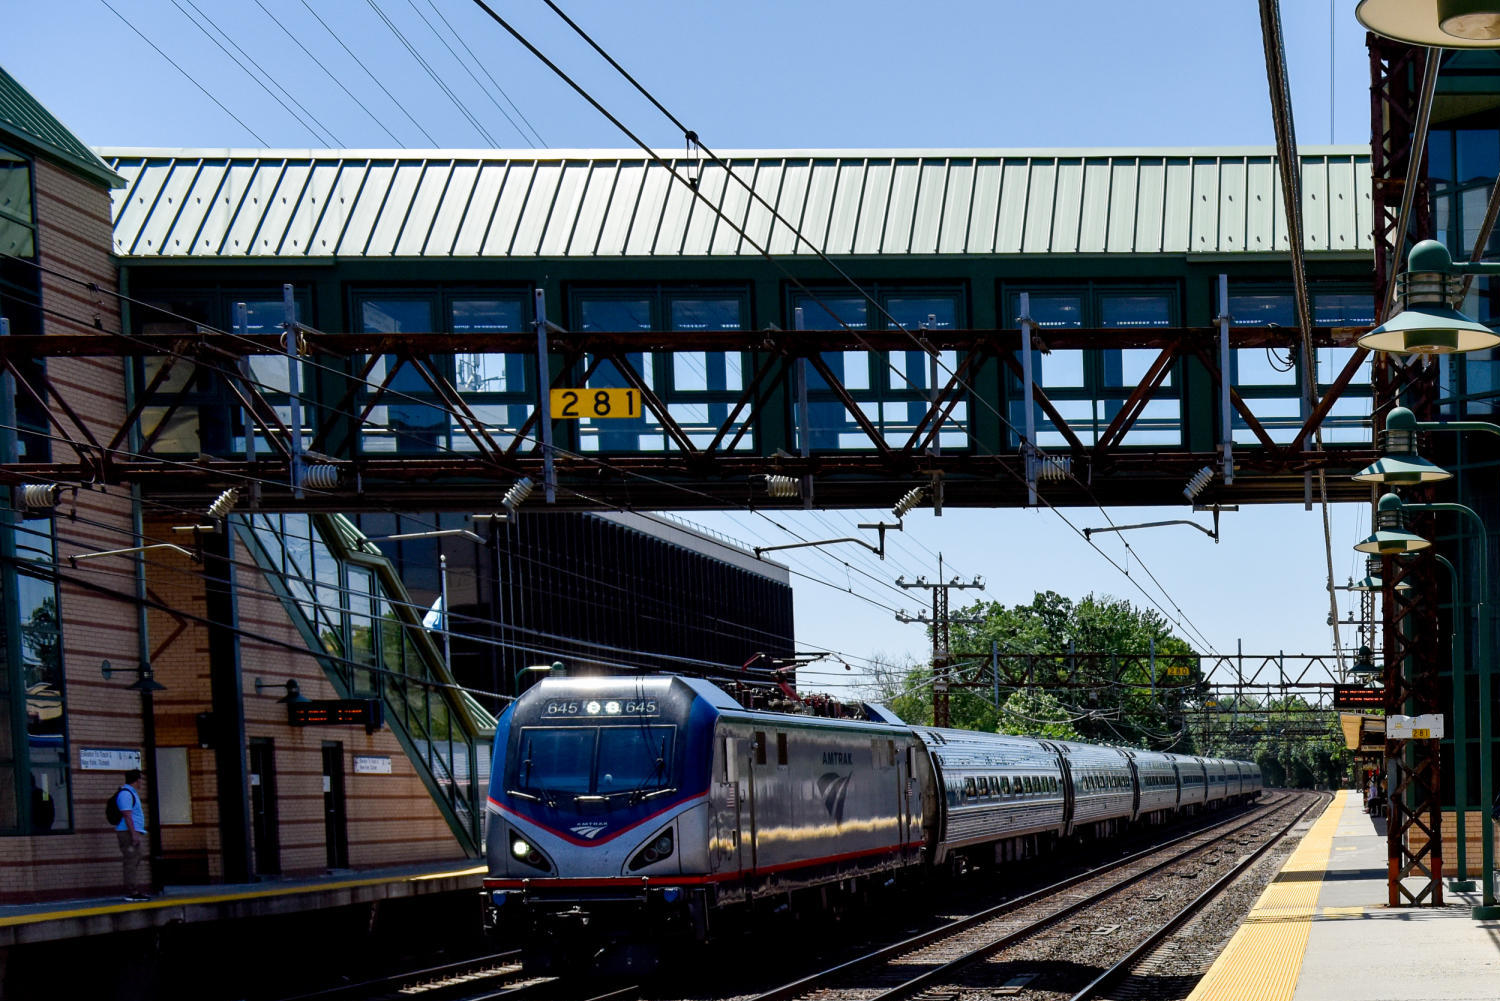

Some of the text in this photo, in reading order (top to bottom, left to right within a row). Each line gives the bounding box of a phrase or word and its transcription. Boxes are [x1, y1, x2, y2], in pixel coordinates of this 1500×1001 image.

[562, 390, 633, 416] 281
[547, 702, 578, 714] 645
[626, 701, 656, 712] 645
[822, 751, 853, 765] AMTRAK
